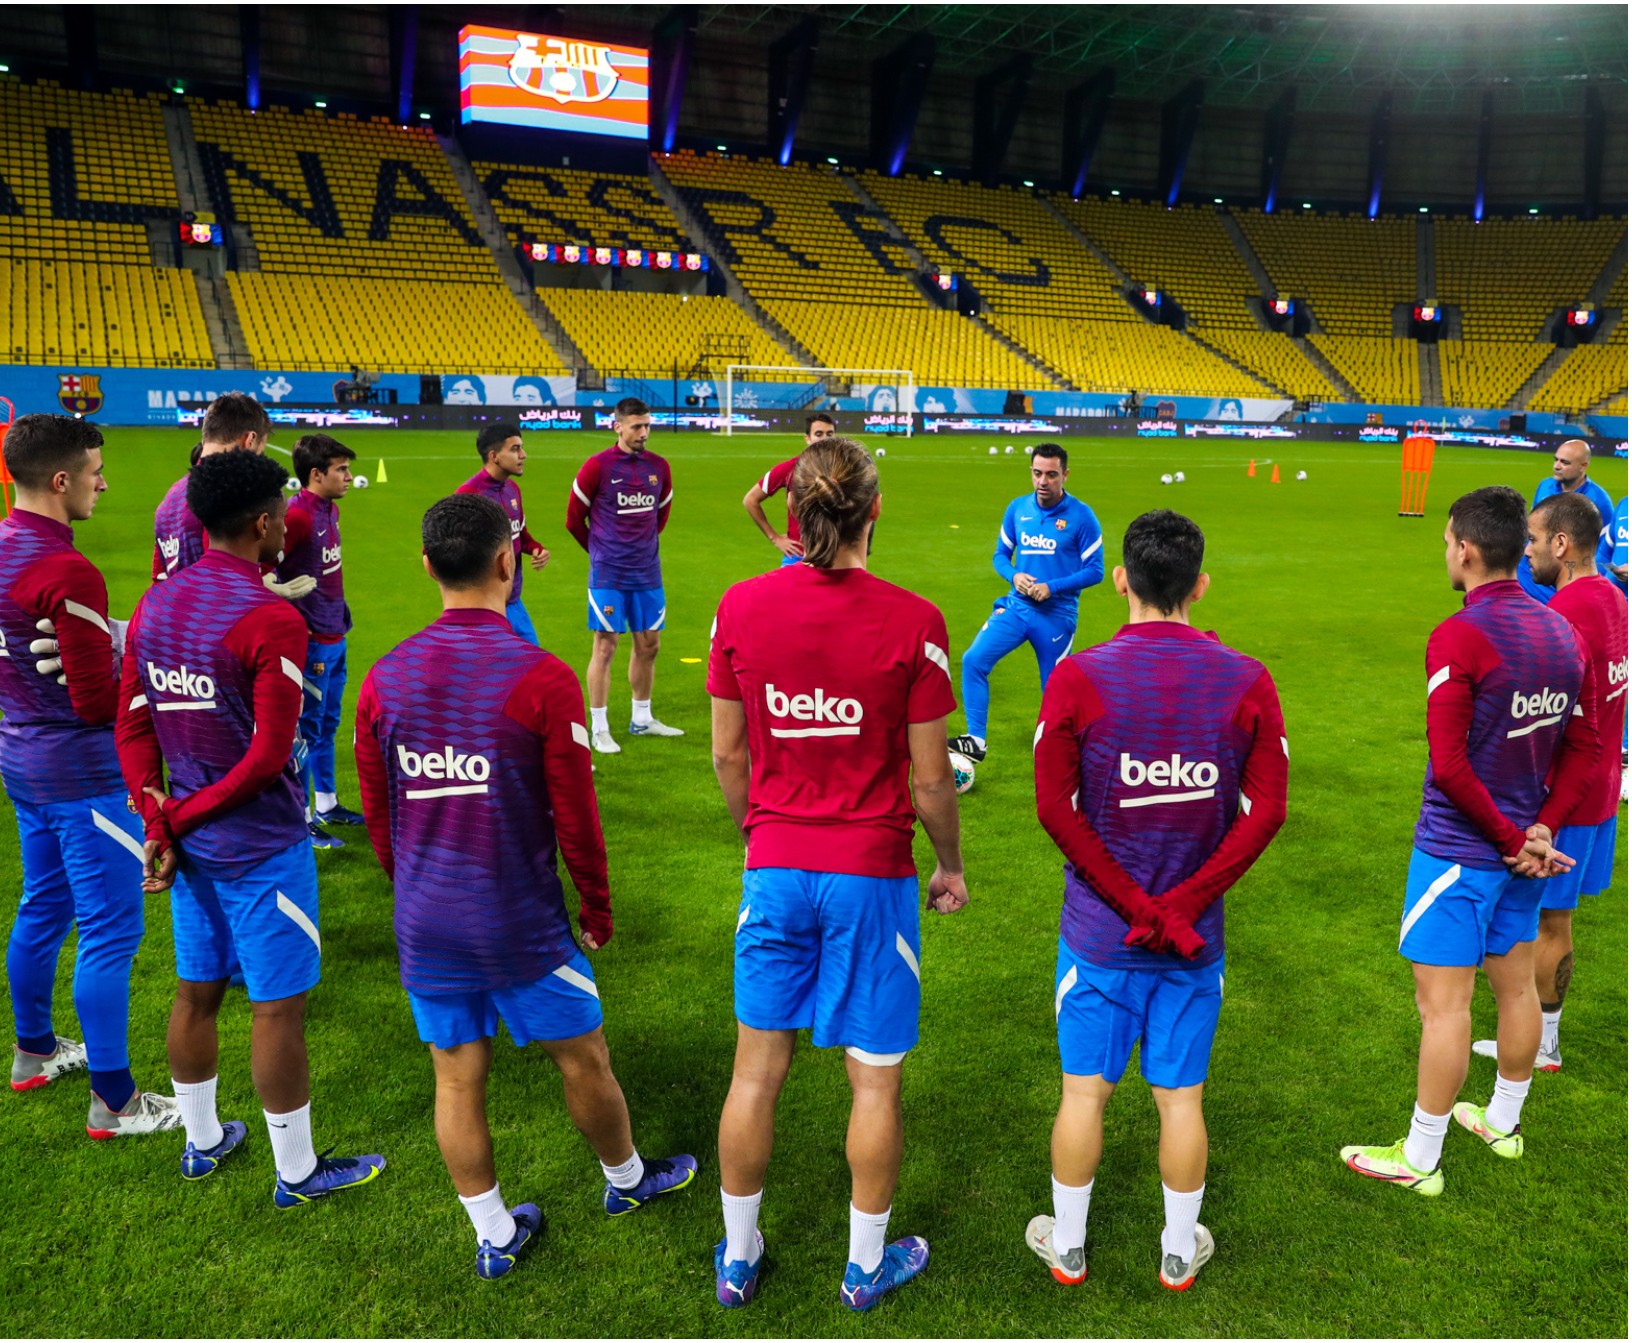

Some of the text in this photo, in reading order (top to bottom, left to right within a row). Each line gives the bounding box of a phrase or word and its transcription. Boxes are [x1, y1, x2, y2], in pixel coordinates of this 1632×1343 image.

[617, 492, 655, 506] beko
[1020, 531, 1057, 550] beko
[147, 661, 216, 700] beko
[766, 683, 864, 725] beko
[1511, 687, 1568, 719] beko
[396, 744, 491, 782] beko
[1120, 753, 1219, 788] beko
